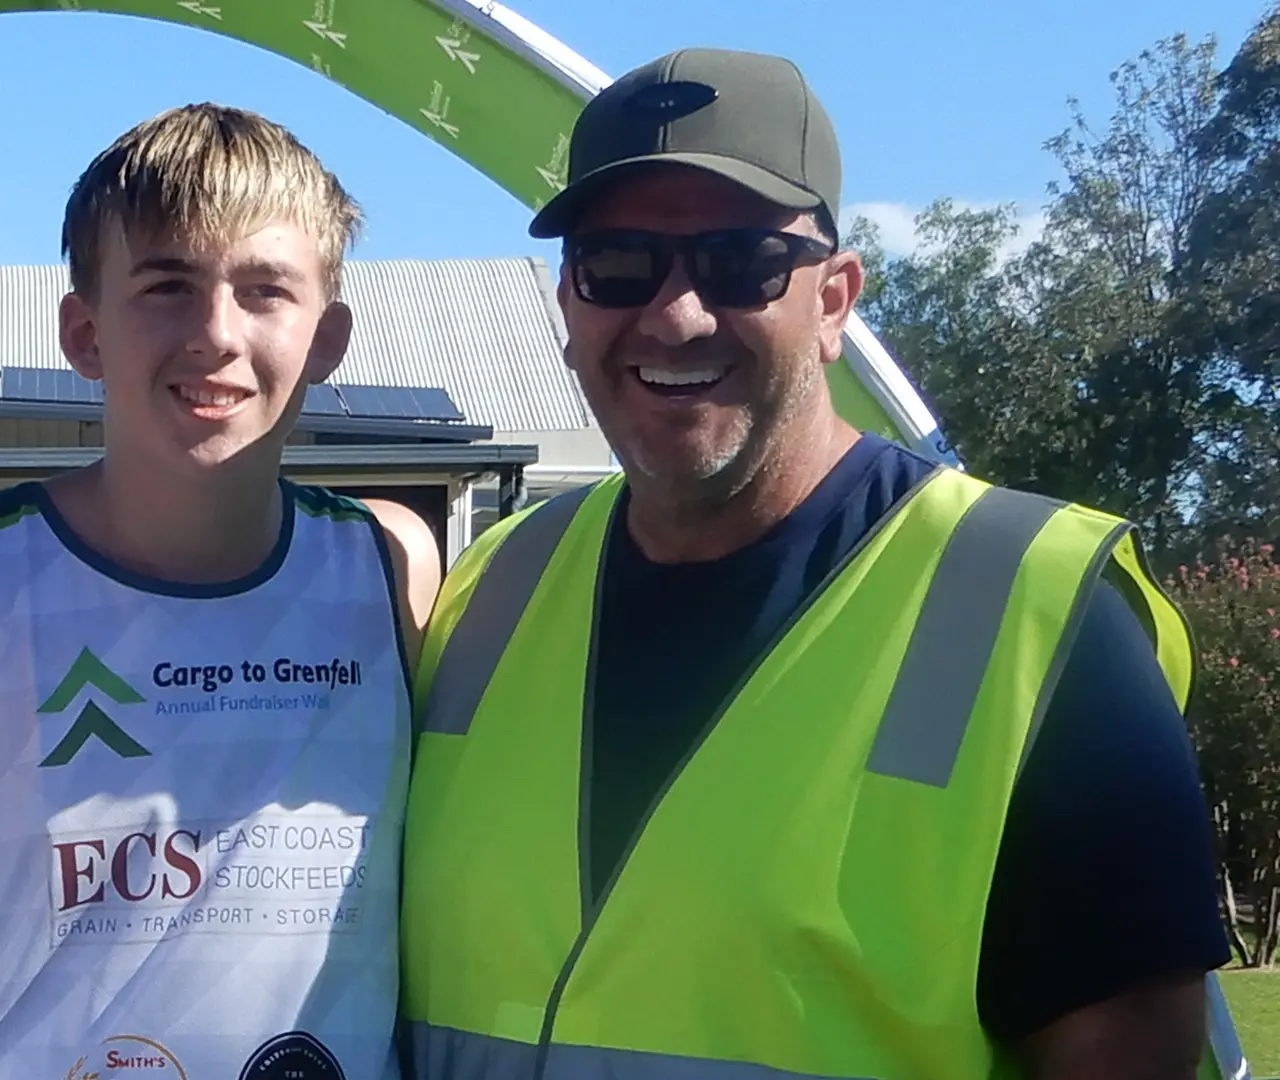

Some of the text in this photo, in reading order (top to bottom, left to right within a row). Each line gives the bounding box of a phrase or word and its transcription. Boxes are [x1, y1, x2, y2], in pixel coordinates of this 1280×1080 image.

[153, 658, 362, 692] Cargo to Grenfell
[156, 695, 216, 715] Annual
[220, 694, 299, 711] Fundraiser
[217, 825, 370, 852] EAST COAST
[54, 829, 202, 912] ECS
[215, 865, 367, 889] STOCKFEEDS
[57, 918, 117, 938] GRAIN
[143, 907, 254, 932] TRANSPORT
